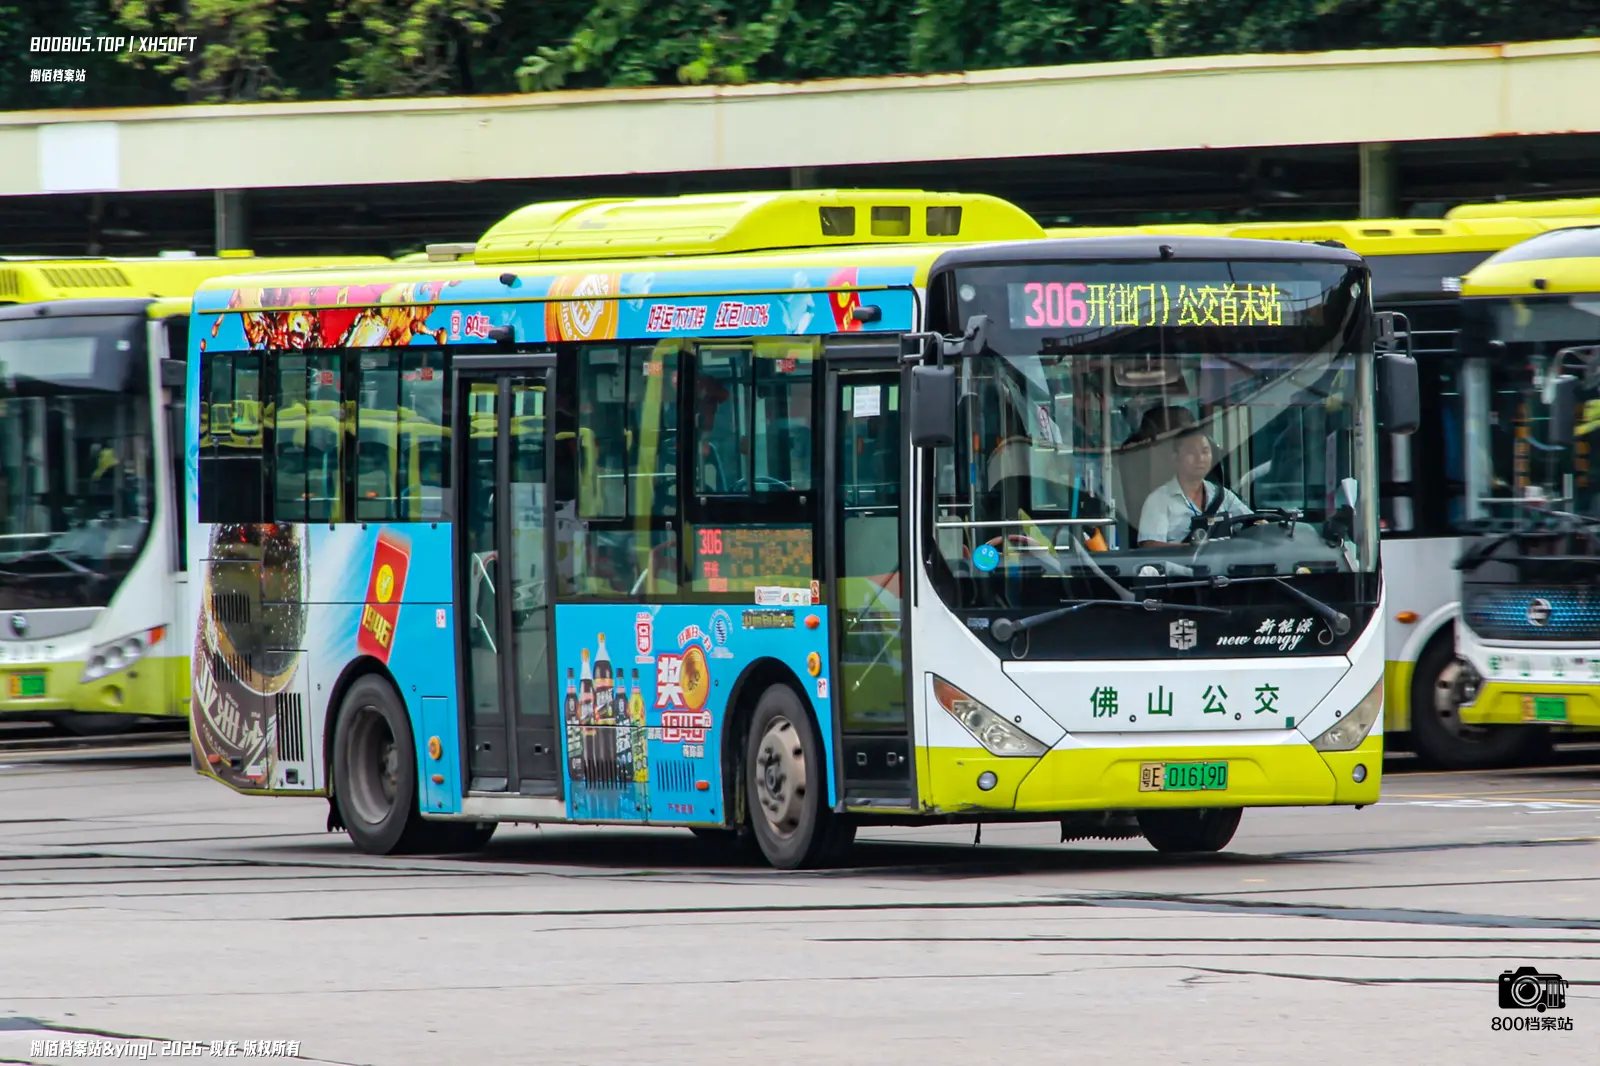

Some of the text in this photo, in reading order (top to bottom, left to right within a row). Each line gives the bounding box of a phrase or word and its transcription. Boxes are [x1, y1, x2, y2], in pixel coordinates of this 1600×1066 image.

[1023, 282, 1087, 327] 306
[698, 528, 723, 555] 306
[1256, 617, 1314, 634] 新能源
[1216, 634, 1304, 651] new energy
[1090, 683, 1281, 718] 佛山公交
